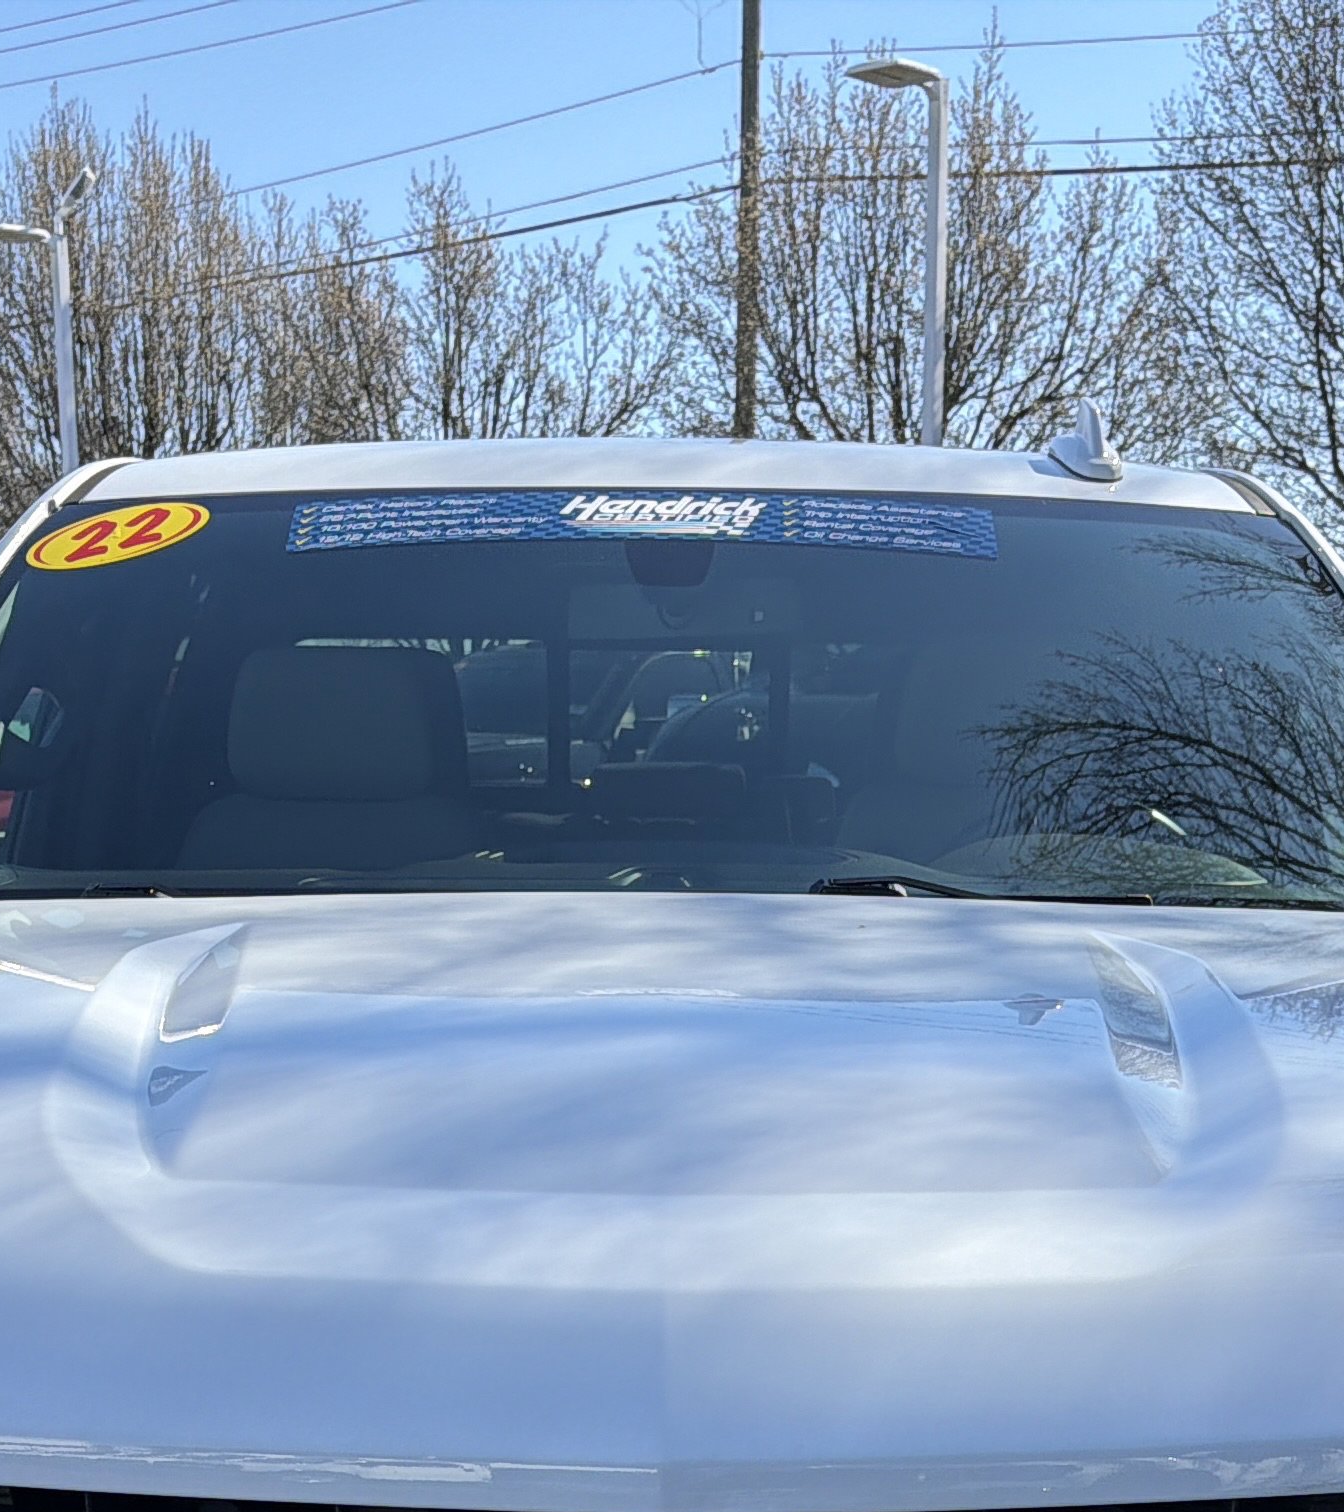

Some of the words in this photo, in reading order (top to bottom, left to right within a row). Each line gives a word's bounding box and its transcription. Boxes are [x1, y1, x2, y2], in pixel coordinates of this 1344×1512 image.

[560, 495, 767, 521] Hendrick
[592, 513, 755, 523] CERTIFIED
[64, 508, 171, 563] 22
